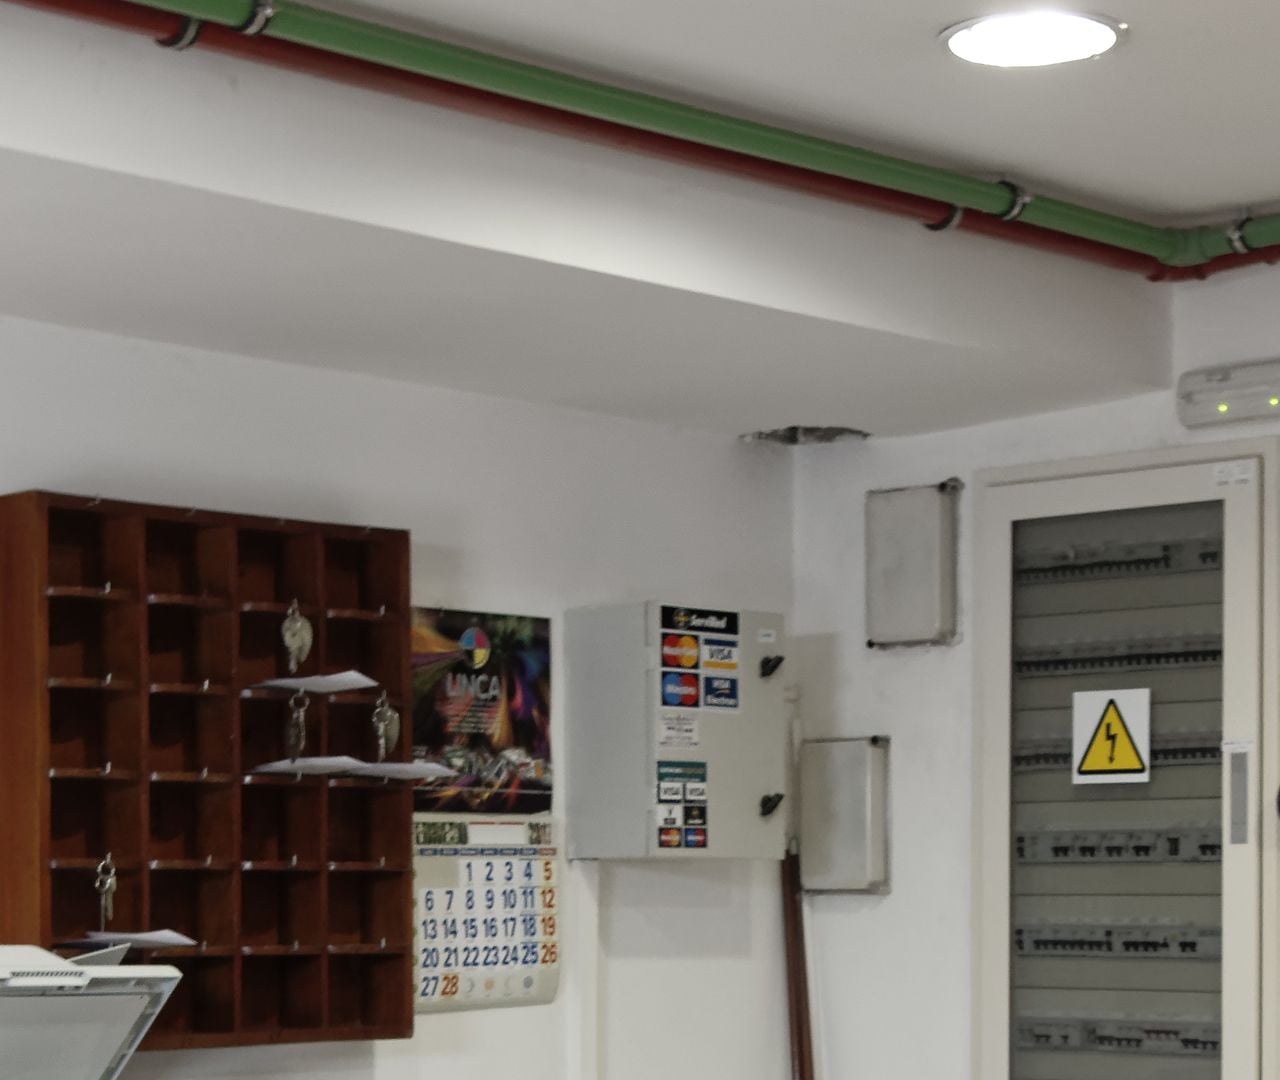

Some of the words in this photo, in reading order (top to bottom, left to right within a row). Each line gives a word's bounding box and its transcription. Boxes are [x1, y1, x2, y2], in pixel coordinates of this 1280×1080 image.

[708, 648, 733, 661] VISA
[466, 861, 473, 882] 1
[486, 862, 494, 881] 2
[505, 861, 513, 881] 3
[524, 860, 533, 881] 4
[543, 861, 553, 881] 5
[424, 890, 434, 911] 6
[445, 890, 454, 910] 7
[465, 889, 475, 910] 8
[485, 889, 495, 909] 9
[502, 889, 517, 909] 10
[521, 889, 535, 908] 11
[541, 889, 555, 909] 12
[422, 919, 438, 939] 13
[442, 918, 457, 939] 14
[463, 918, 478, 939] 15
[483, 917, 498, 938] 16
[502, 917, 517, 937] 17
[521, 916, 537, 937] 18
[541, 916, 556, 936] 19
[422, 948, 439, 968] 20
[443, 947, 459, 968] 21
[462, 947, 479, 967] 22
[483, 946, 499, 966] 23
[502, 945, 518, 965] 24
[521, 945, 539, 965] 25
[541, 945, 557, 964] 26
[421, 976, 439, 997] 27
[441, 975, 460, 996] 28
